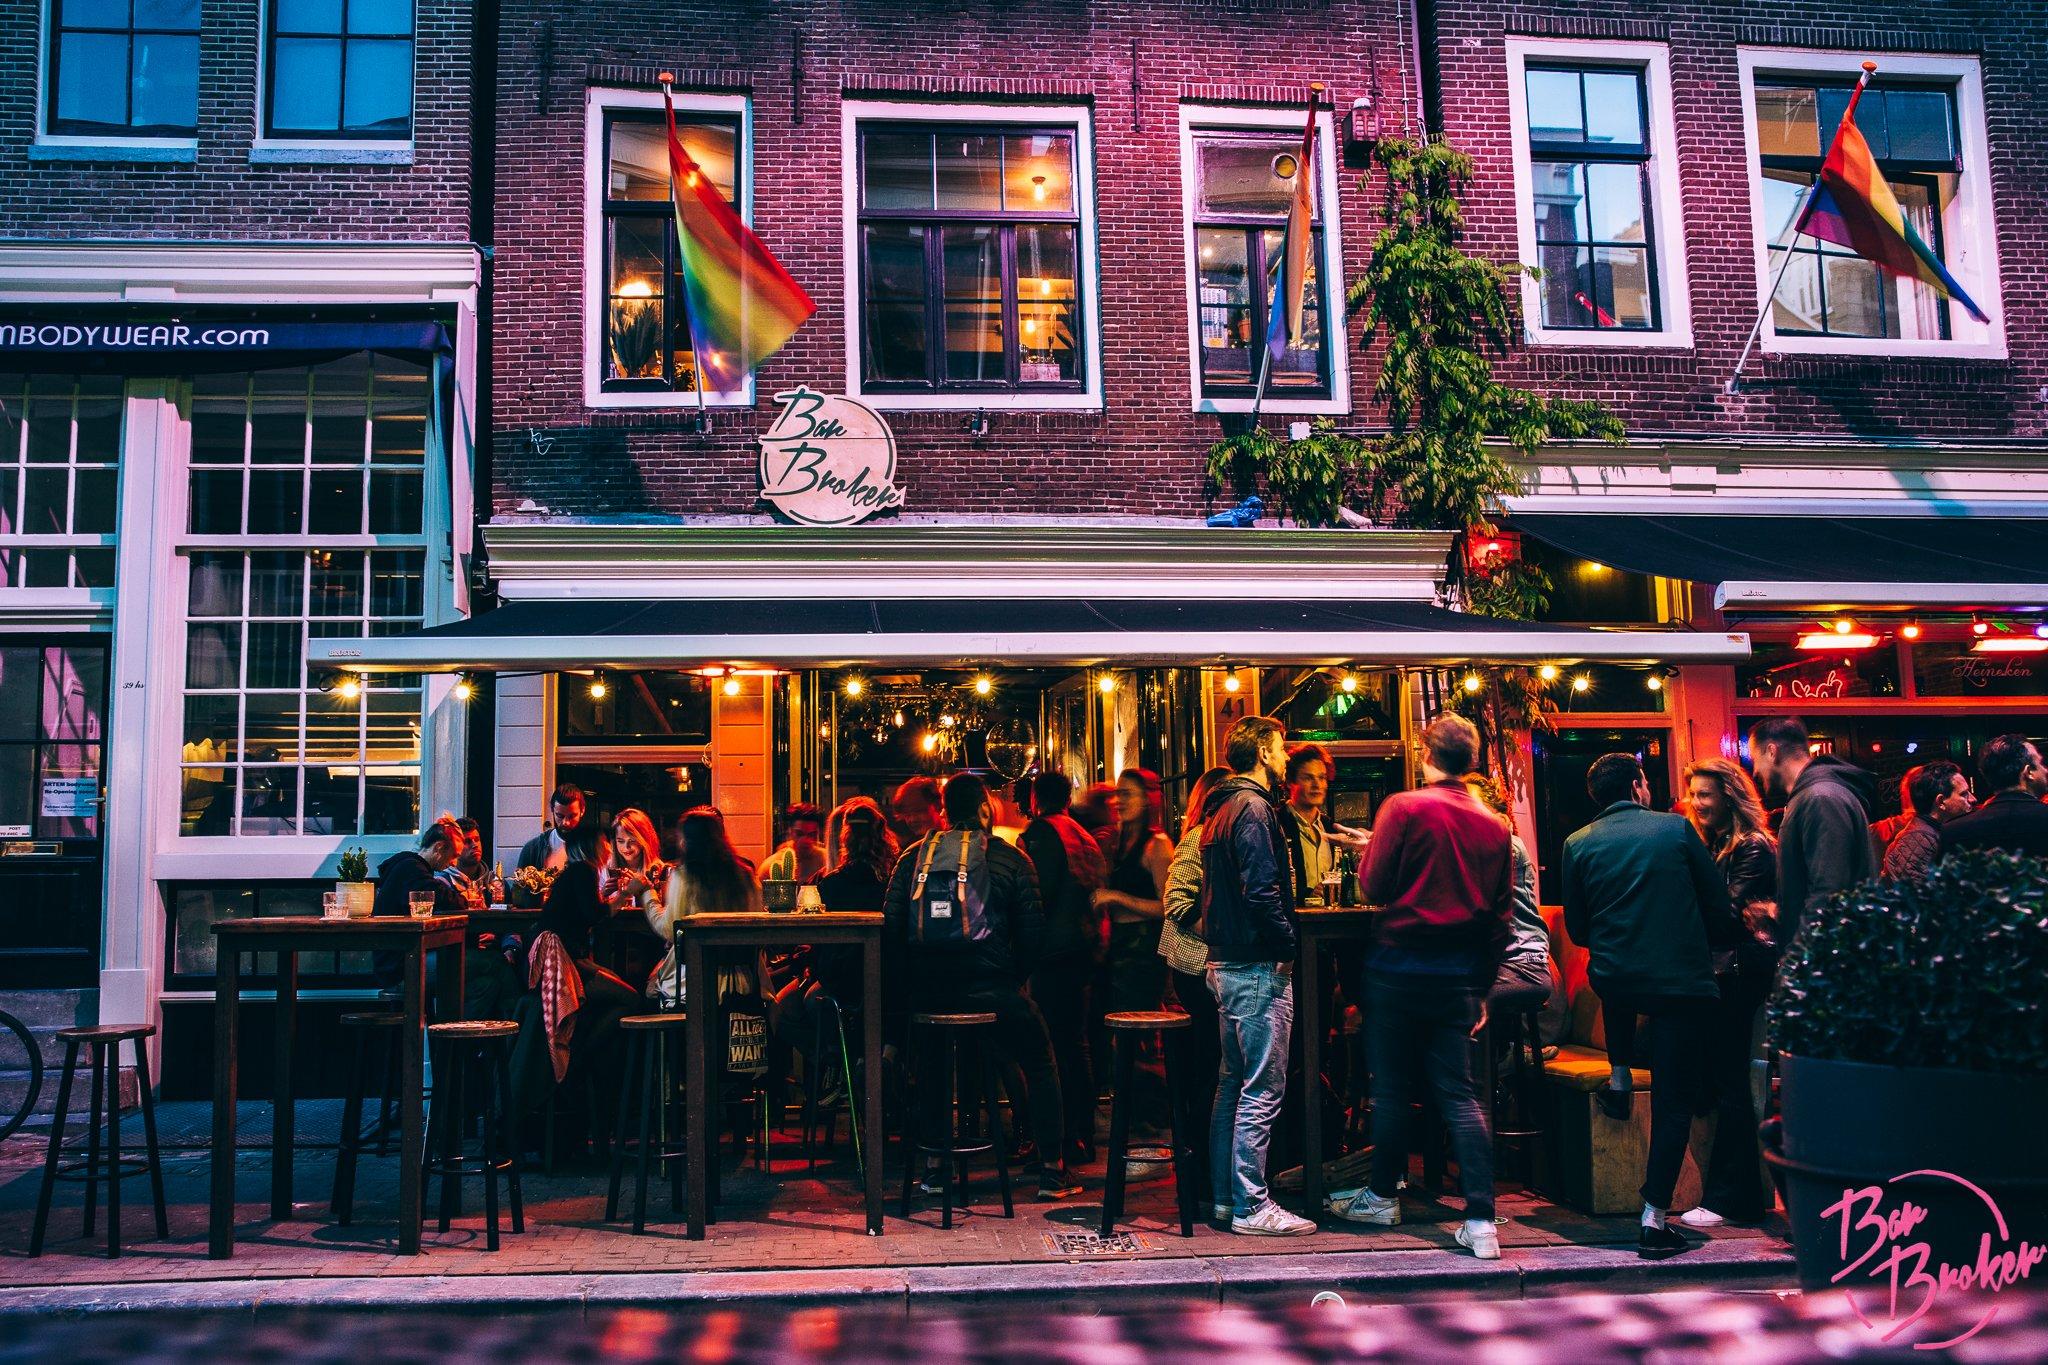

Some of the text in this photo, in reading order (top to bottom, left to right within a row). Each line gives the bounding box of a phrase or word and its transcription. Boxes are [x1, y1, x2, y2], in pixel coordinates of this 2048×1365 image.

[763, 388, 847, 442] Bar
[763, 441, 902, 508] Broker
[122, 681, 134, 689] 39
[1952, 655, 2033, 688] Heineken
[1220, 697, 1245, 717] 41
